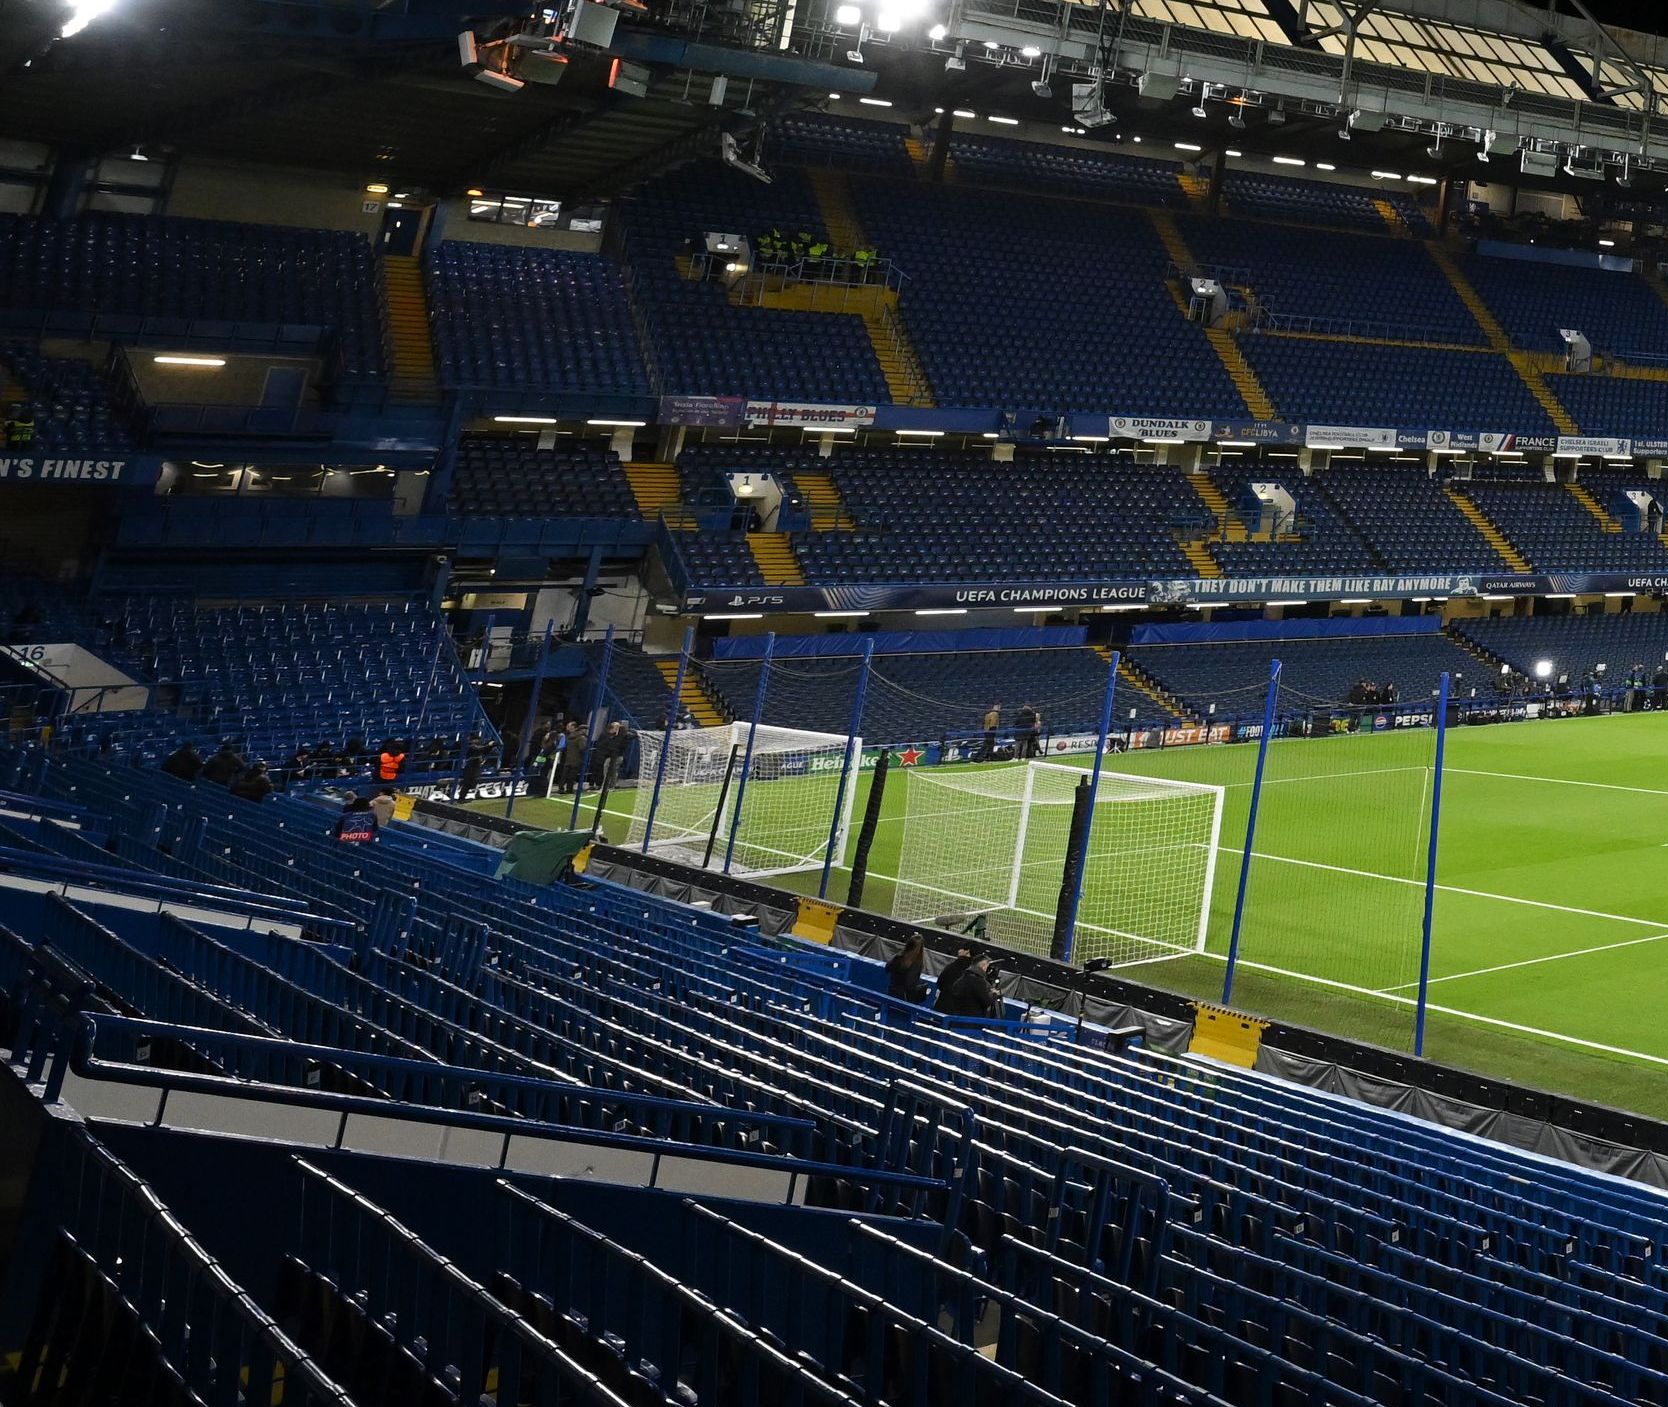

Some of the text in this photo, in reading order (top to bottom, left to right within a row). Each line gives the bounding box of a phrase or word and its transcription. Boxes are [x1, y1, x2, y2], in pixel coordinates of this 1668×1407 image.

[747, 406, 795, 421] PHILLY
[800, 409, 846, 423] BLUES
[1131, 419, 1190, 430] DUNDALK
[1139, 428, 1178, 439] BLUES
[1457, 433, 1473, 441] West
[1398, 435, 1426, 444] Chelsea
[1515, 436, 1555, 446] FRANCE
[1560, 438, 1585, 446] CHELSEA
[1633, 447, 1667, 456] Supporters
[40, 459, 126, 480] FINEST
[1193, 577, 1451, 593] THEY DON'T MAKE THEM LIKE RAY ANYMORE
[1486, 581, 1536, 590] QATAR AIRWAYS
[1628, 578, 1653, 588] UEFA
[956, 587, 1146, 602] UEFA CHAMPIONS LEAGUE
[747, 596, 784, 605] PS5
[1395, 714, 1434, 728] PEPSI
[340, 832, 370, 841] PHOTO
